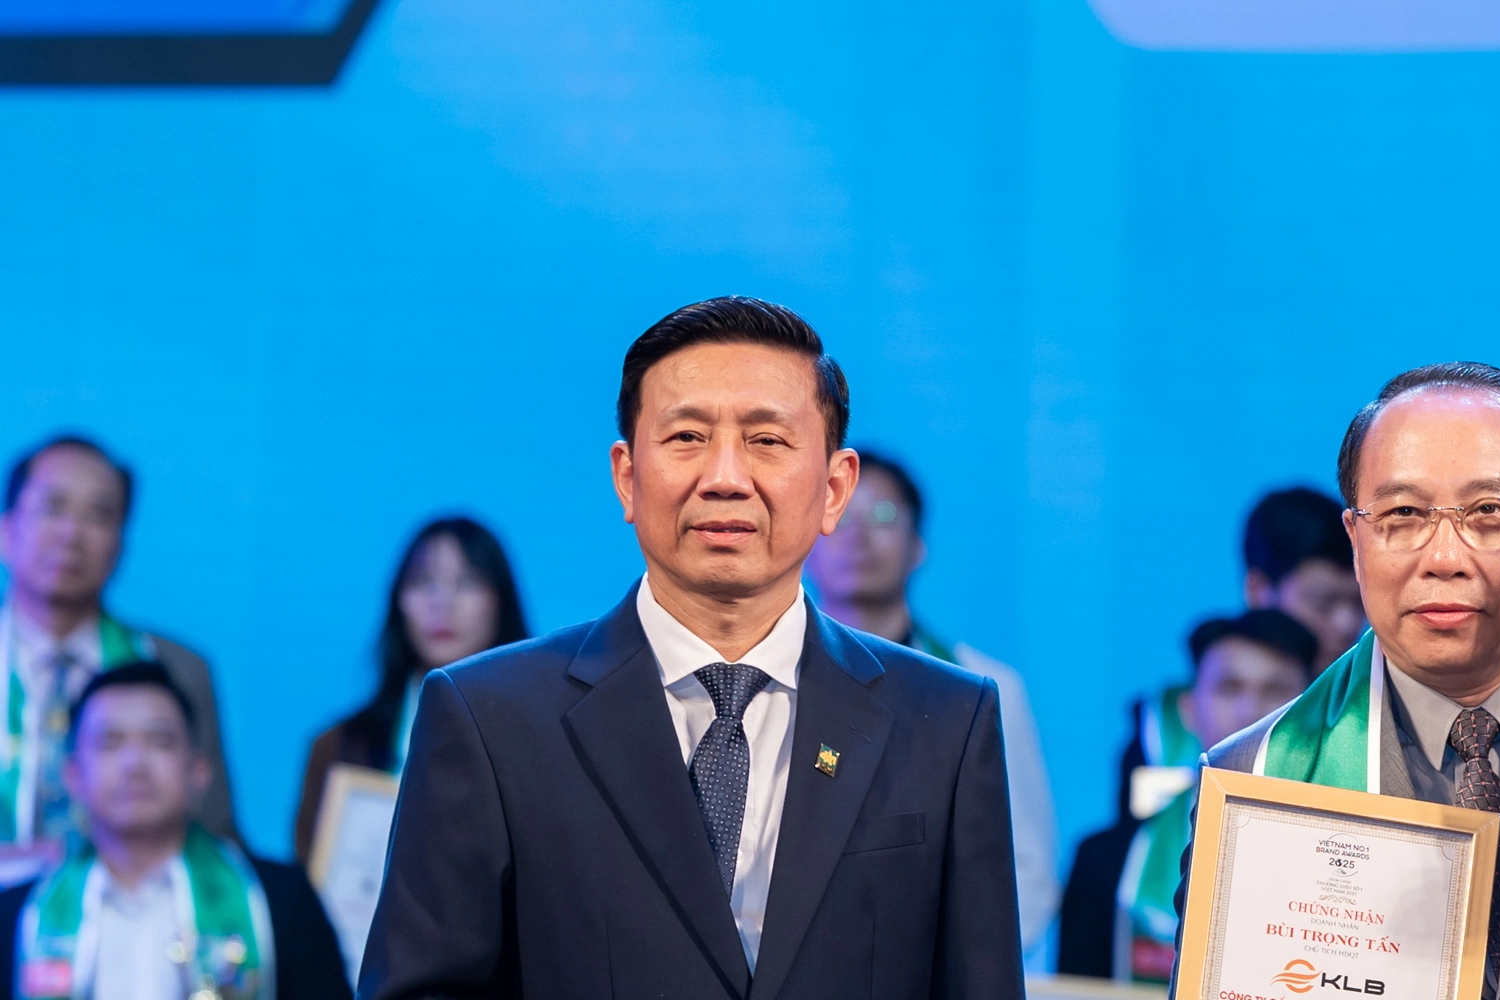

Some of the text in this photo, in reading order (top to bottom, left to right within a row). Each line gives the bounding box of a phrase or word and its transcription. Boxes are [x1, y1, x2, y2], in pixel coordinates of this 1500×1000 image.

[1316, 847, 1370, 860] BRAND AWARDS
[1319, 840, 1351, 850] VIETNAM
[1288, 901, 1385, 925] CHỨNG NHẬN
[1311, 918, 1359, 930] DOANH NHÂN
[1266, 922, 1401, 954] BÙI TRỌNG TẤN
[1321, 972, 1385, 996] KLB
